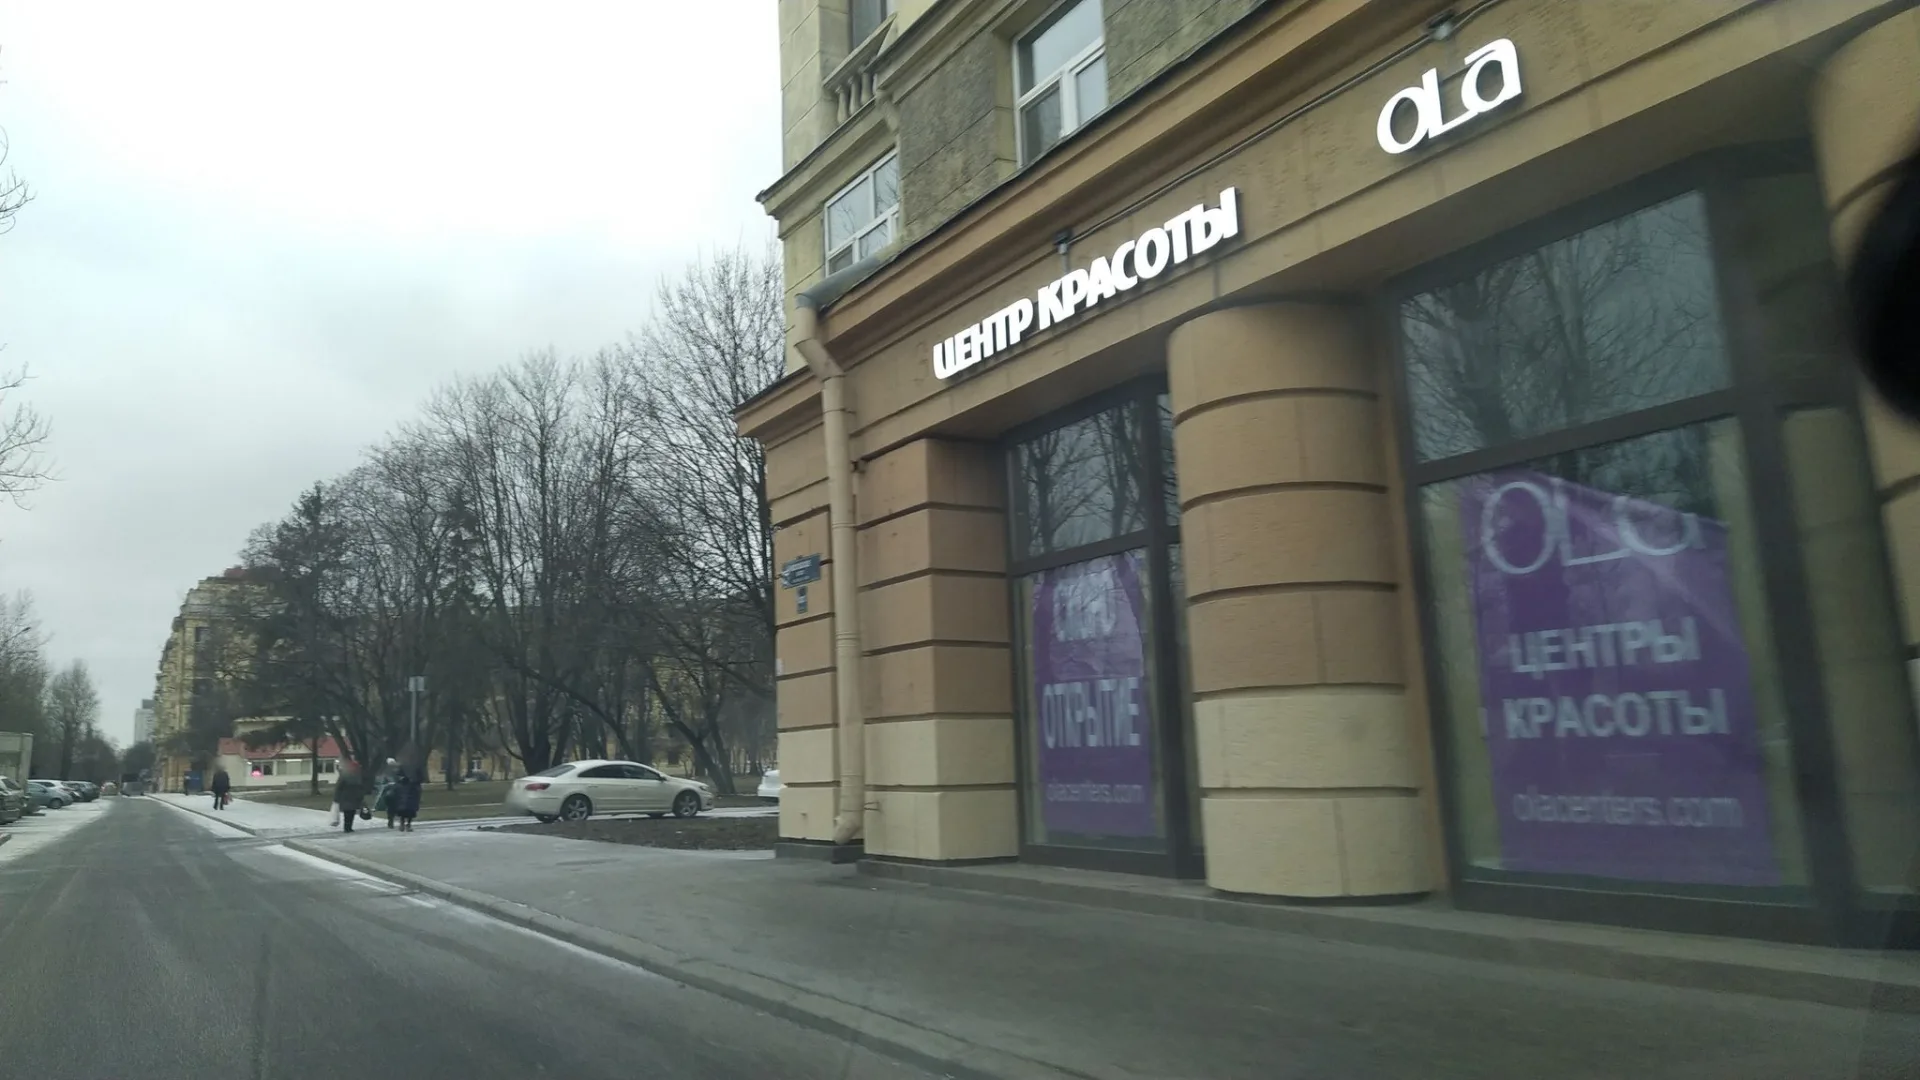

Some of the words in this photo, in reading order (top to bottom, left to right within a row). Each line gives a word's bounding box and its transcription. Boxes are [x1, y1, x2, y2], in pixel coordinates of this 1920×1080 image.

[933, 298, 1033, 380] ЦЕНТР
[1037, 186, 1239, 331] КРАСОТЫ
[1508, 616, 1701, 680] ЦЕНТРЫ
[1042, 677, 1140, 748] ОТКРЫТИЕ
[1503, 688, 1731, 739] КРАСОТЫ
[1513, 785, 1744, 828] olacenters.com
